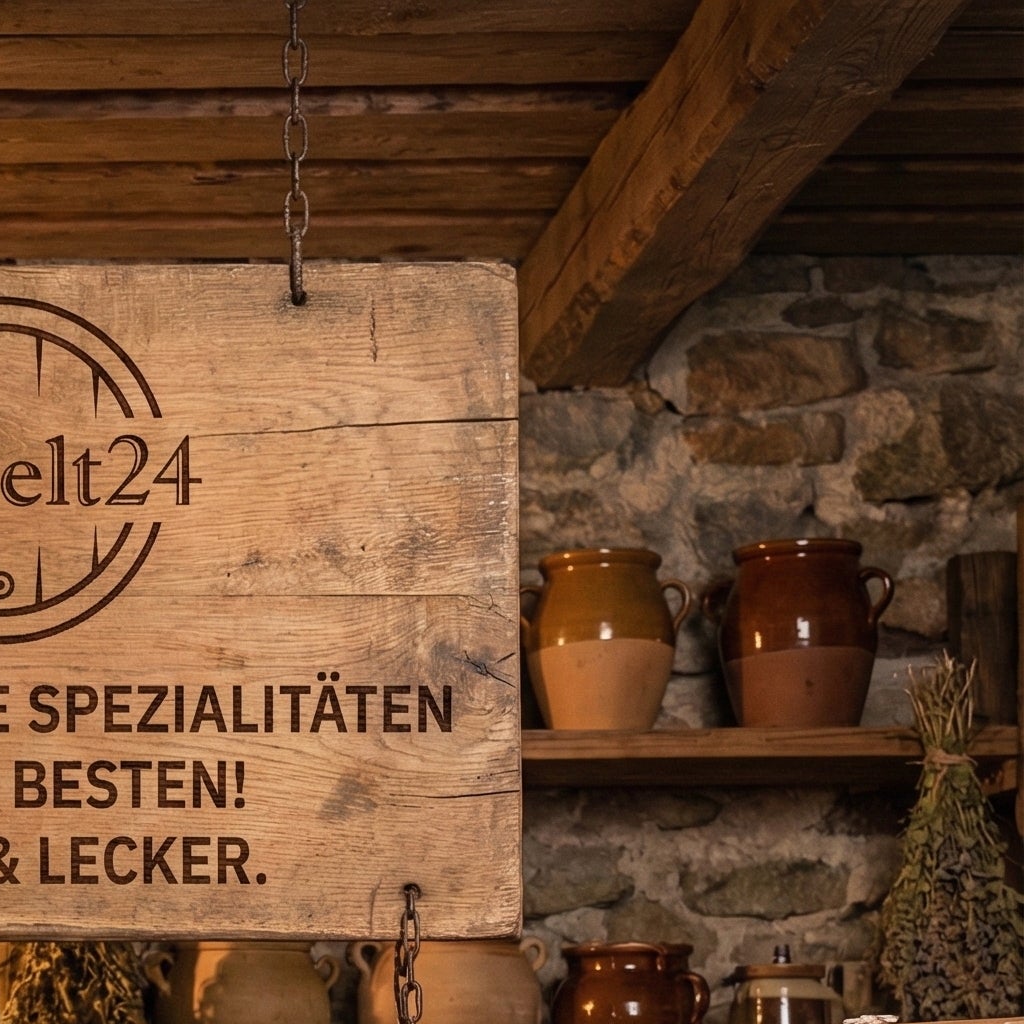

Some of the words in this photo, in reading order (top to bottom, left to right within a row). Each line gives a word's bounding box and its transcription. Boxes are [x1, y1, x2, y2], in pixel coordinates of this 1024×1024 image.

[28, 671, 453, 733] SPEZIALITÄTEN
[13, 759, 246, 809] BESTEN!
[40, 835, 267, 885] LECKER.
